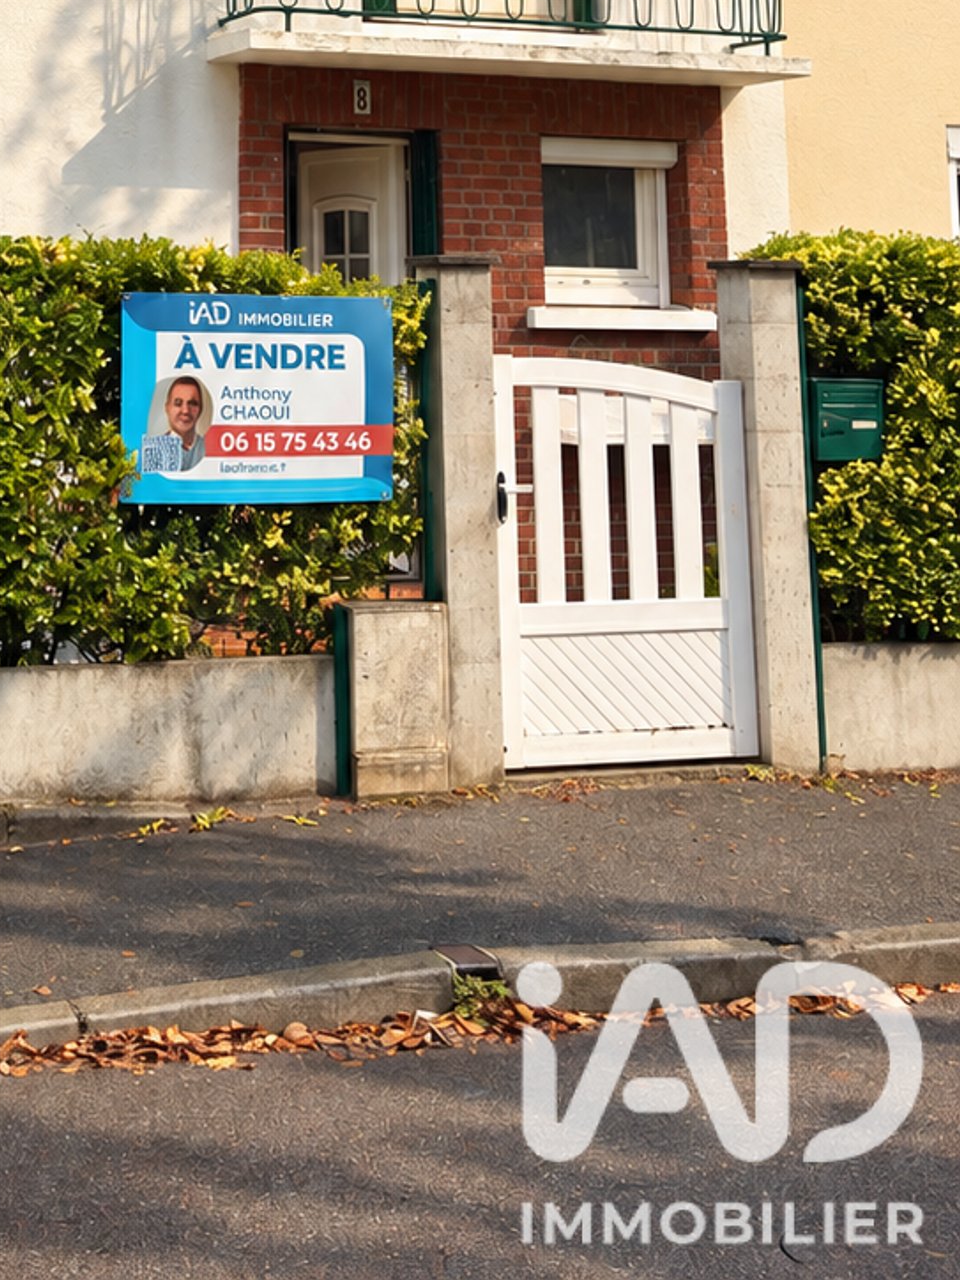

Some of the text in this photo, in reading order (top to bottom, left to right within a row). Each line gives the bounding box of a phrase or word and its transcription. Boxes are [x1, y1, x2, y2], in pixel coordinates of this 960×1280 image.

[356, 86, 368, 111] 8
[238, 312, 334, 327] IMMOBILIER
[174, 335, 347, 370] À VENDRE
[220, 385, 292, 405] Anthony
[220, 405, 290, 421] CHAOUI
[220, 431, 372, 452] 06 15 75 43 46
